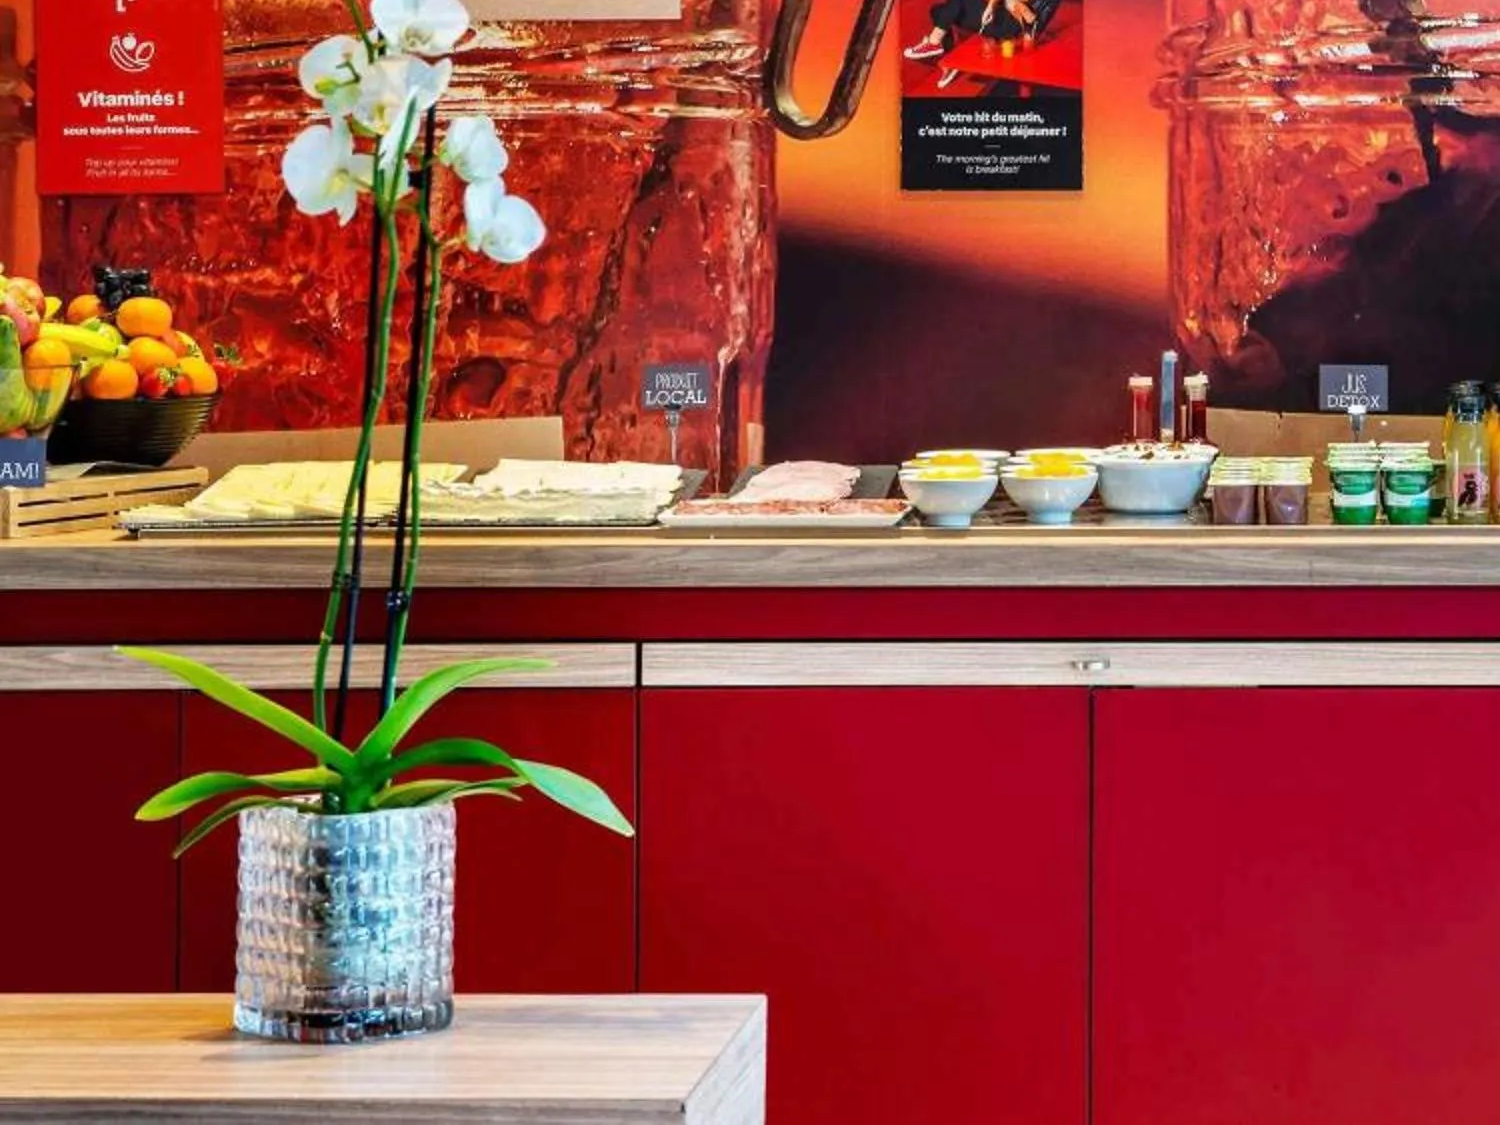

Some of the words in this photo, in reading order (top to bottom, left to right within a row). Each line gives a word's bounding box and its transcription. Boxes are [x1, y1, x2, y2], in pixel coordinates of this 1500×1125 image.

[78, 90, 175, 107] Vitaminés
[177, 91, 185, 106] !
[107, 113, 125, 123] Les
[127, 112, 156, 123] fruits
[941, 112, 972, 124] Votre
[974, 111, 990, 123] hit
[992, 112, 1006, 123] du
[1008, 112, 1045, 124] matin,
[949, 126, 979, 137] notre
[981, 126, 1008, 139] petit
[1010, 125, 1060, 139] déjeuner
[655, 372, 699, 389] PRODUIT
[1341, 372, 1367, 394] JUS
[645, 389, 707, 405] LOCAL
[1327, 394, 1380, 408] DETOX
